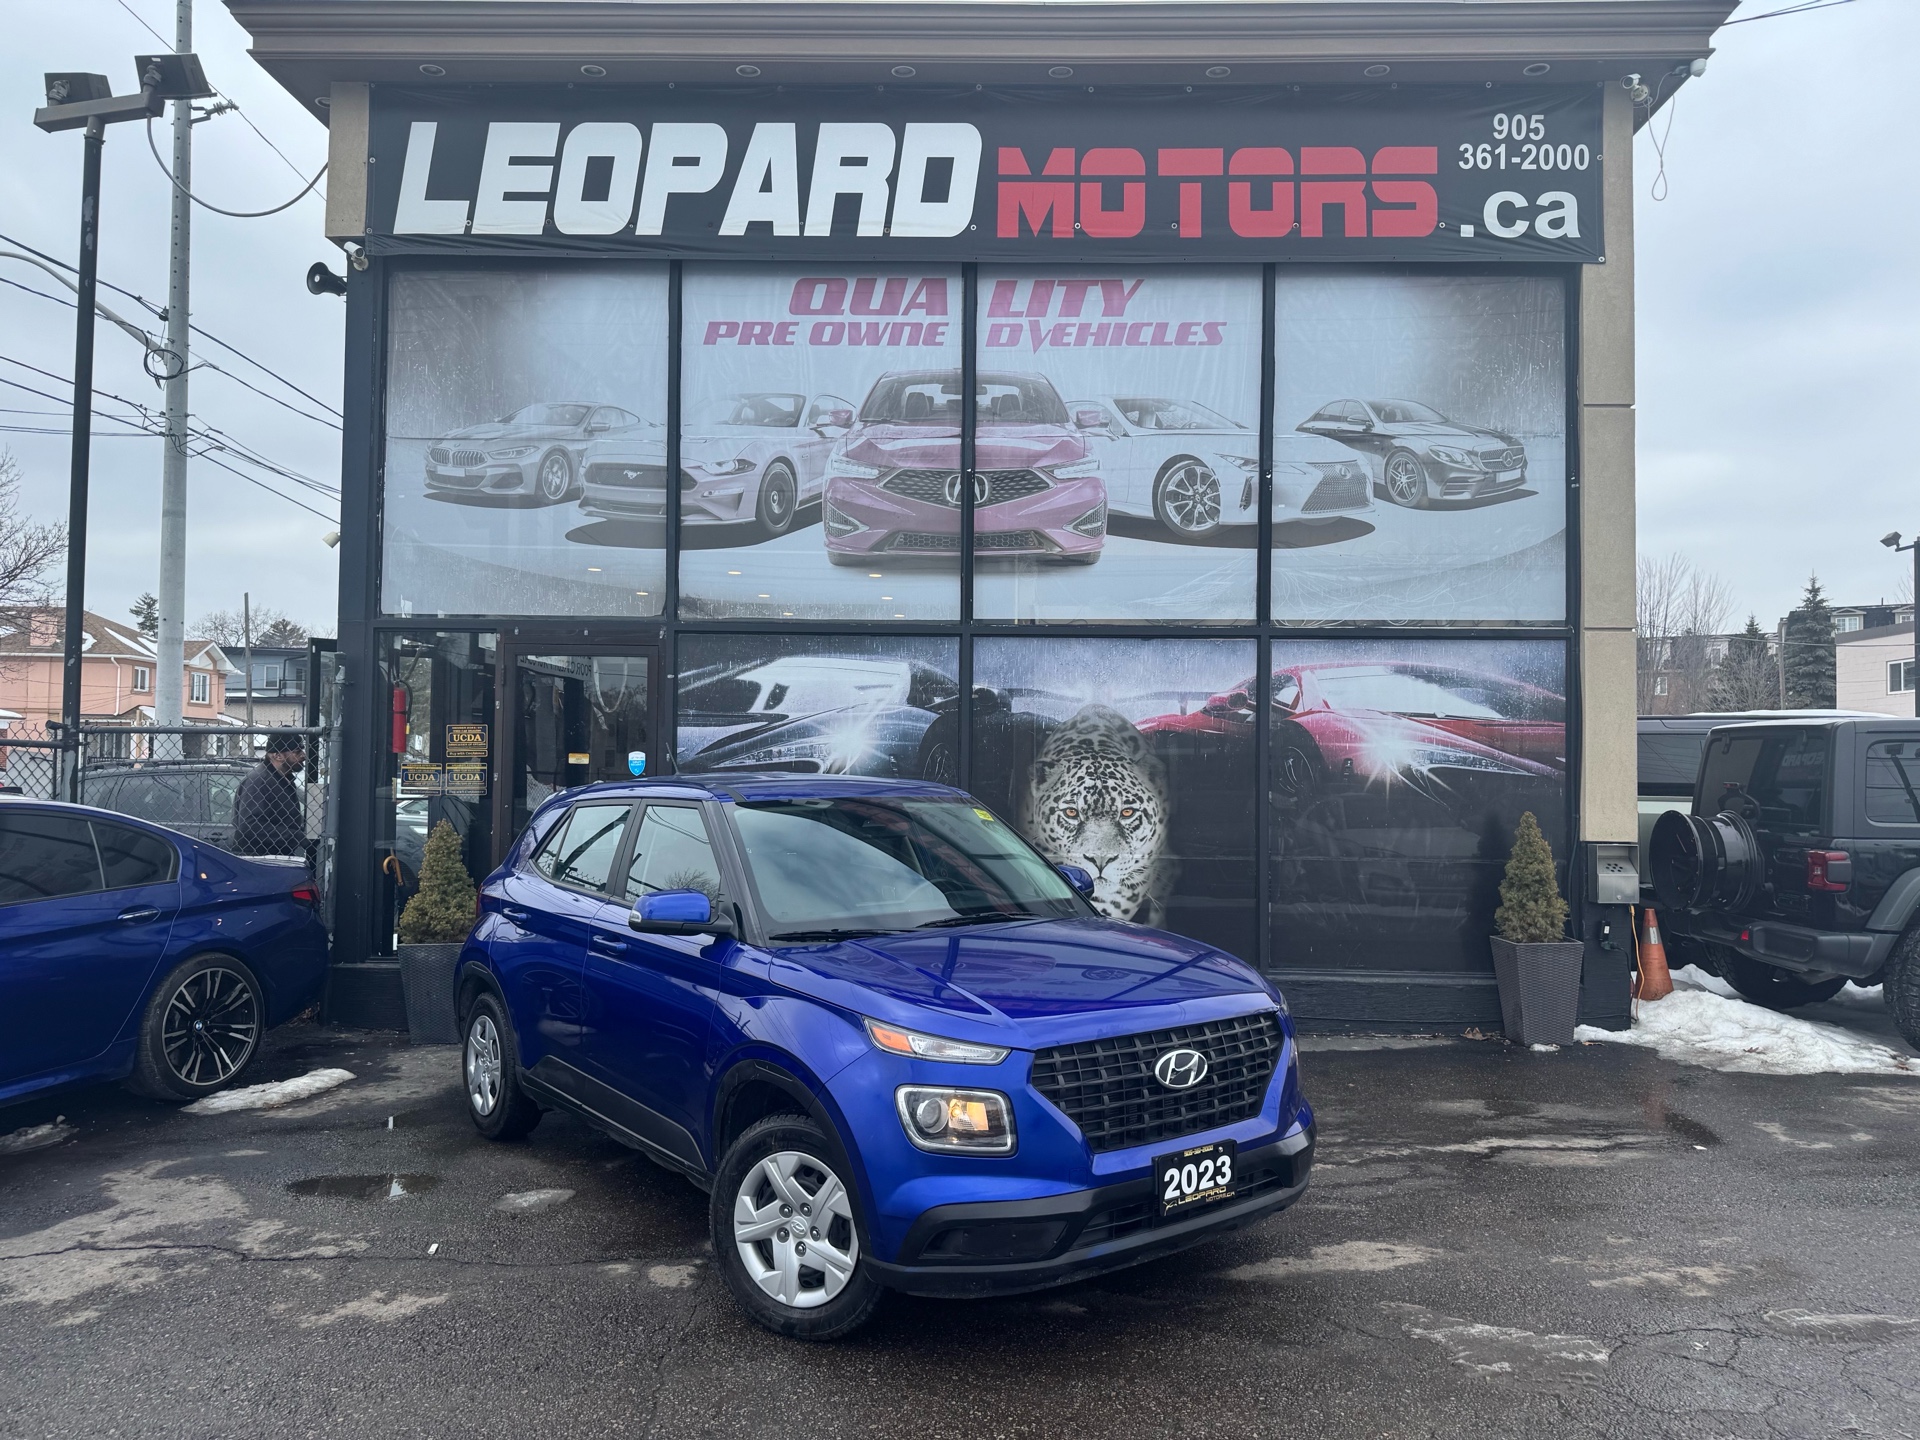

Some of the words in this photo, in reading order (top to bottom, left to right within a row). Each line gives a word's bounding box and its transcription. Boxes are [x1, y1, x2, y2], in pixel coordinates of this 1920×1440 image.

[1493, 113, 1545, 140] 905
[1458, 143, 1590, 171] 361-2000
[393, 121, 983, 237] LEOPARD
[997, 146, 1438, 239] MOTORS
[1460, 190, 1581, 239] .ca
[703, 321, 800, 346] PRE
[1164, 1155, 1231, 1199] 2023
[1178, 1186, 1226, 1204] LEOPARD
